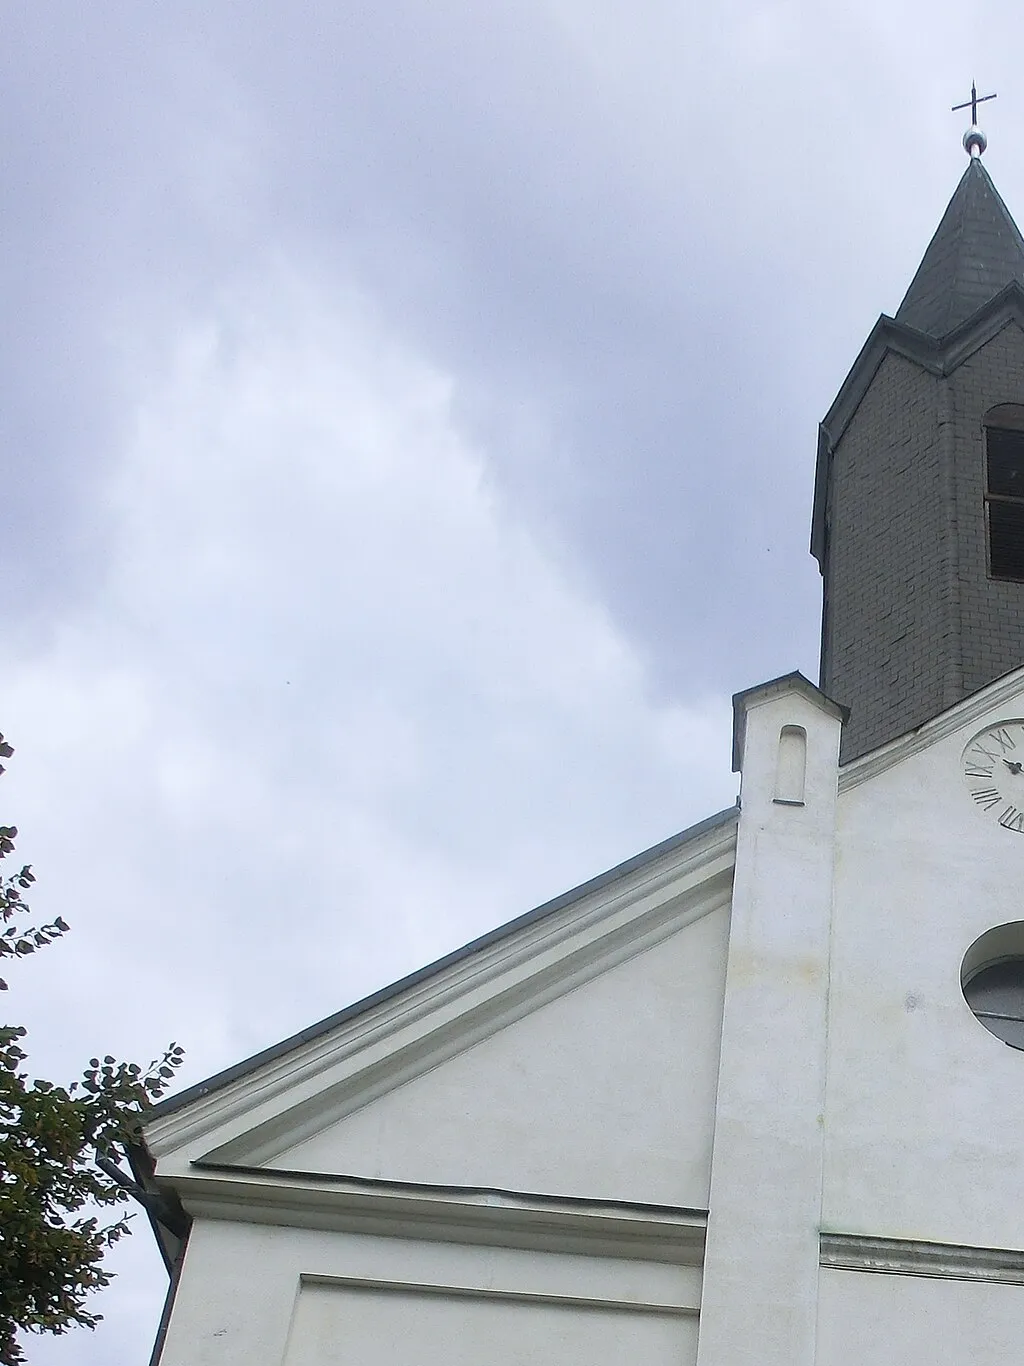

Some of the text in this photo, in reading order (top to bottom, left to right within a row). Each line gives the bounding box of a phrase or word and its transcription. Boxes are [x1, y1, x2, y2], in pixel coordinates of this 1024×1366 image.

[989, 728, 1016, 753] XI
[972, 743, 1000, 763] X
[965, 761, 993, 778] IX
